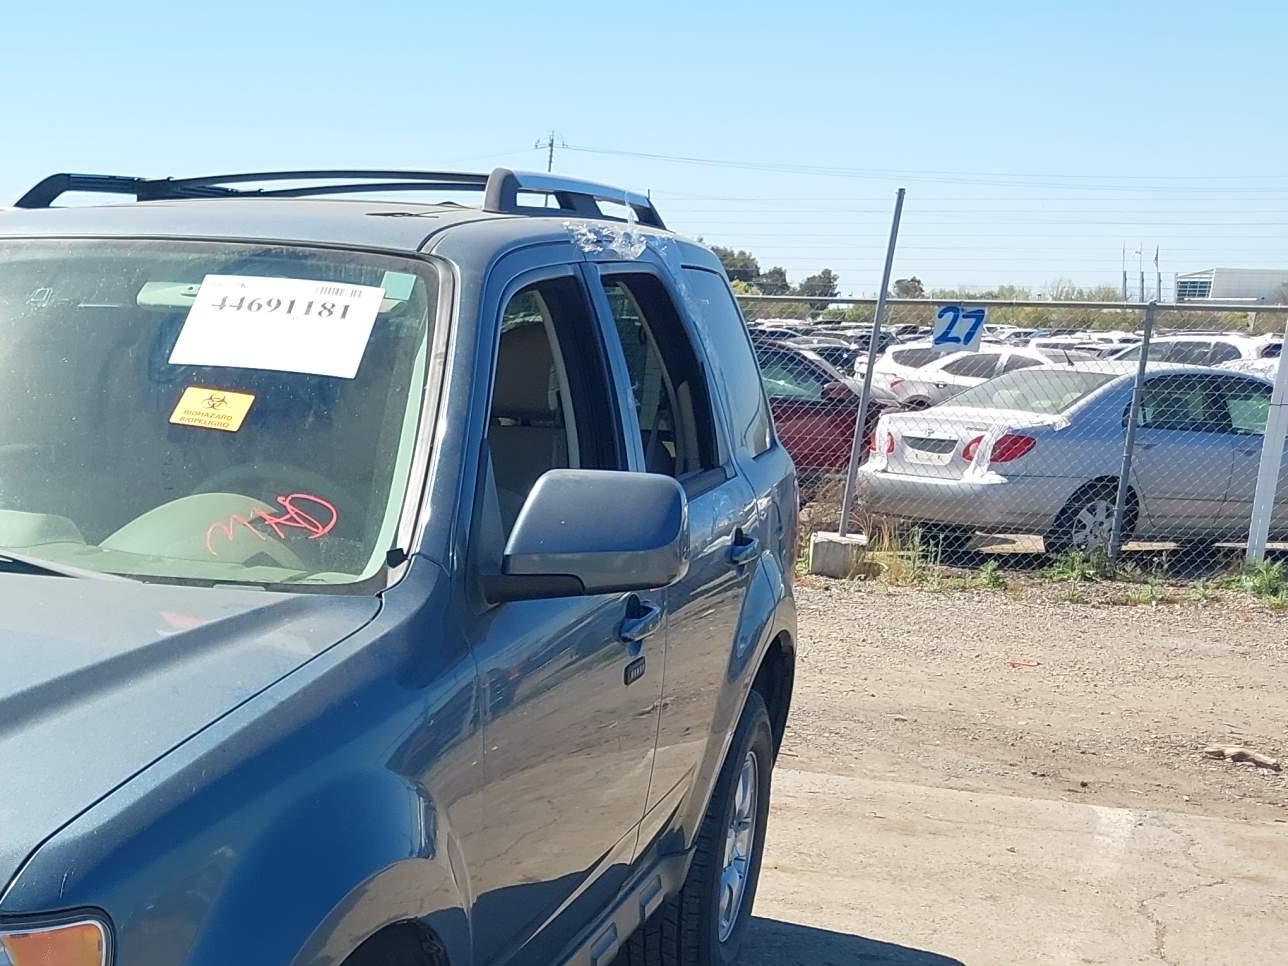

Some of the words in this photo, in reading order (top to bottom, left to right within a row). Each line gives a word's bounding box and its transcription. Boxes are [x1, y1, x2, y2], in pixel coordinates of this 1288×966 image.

[211, 295, 351, 320] 44691181
[934, 305, 985, 346] 27
[179, 416, 230, 428] BIOPELIGRO
[184, 409, 233, 421] BIOHAZARD
